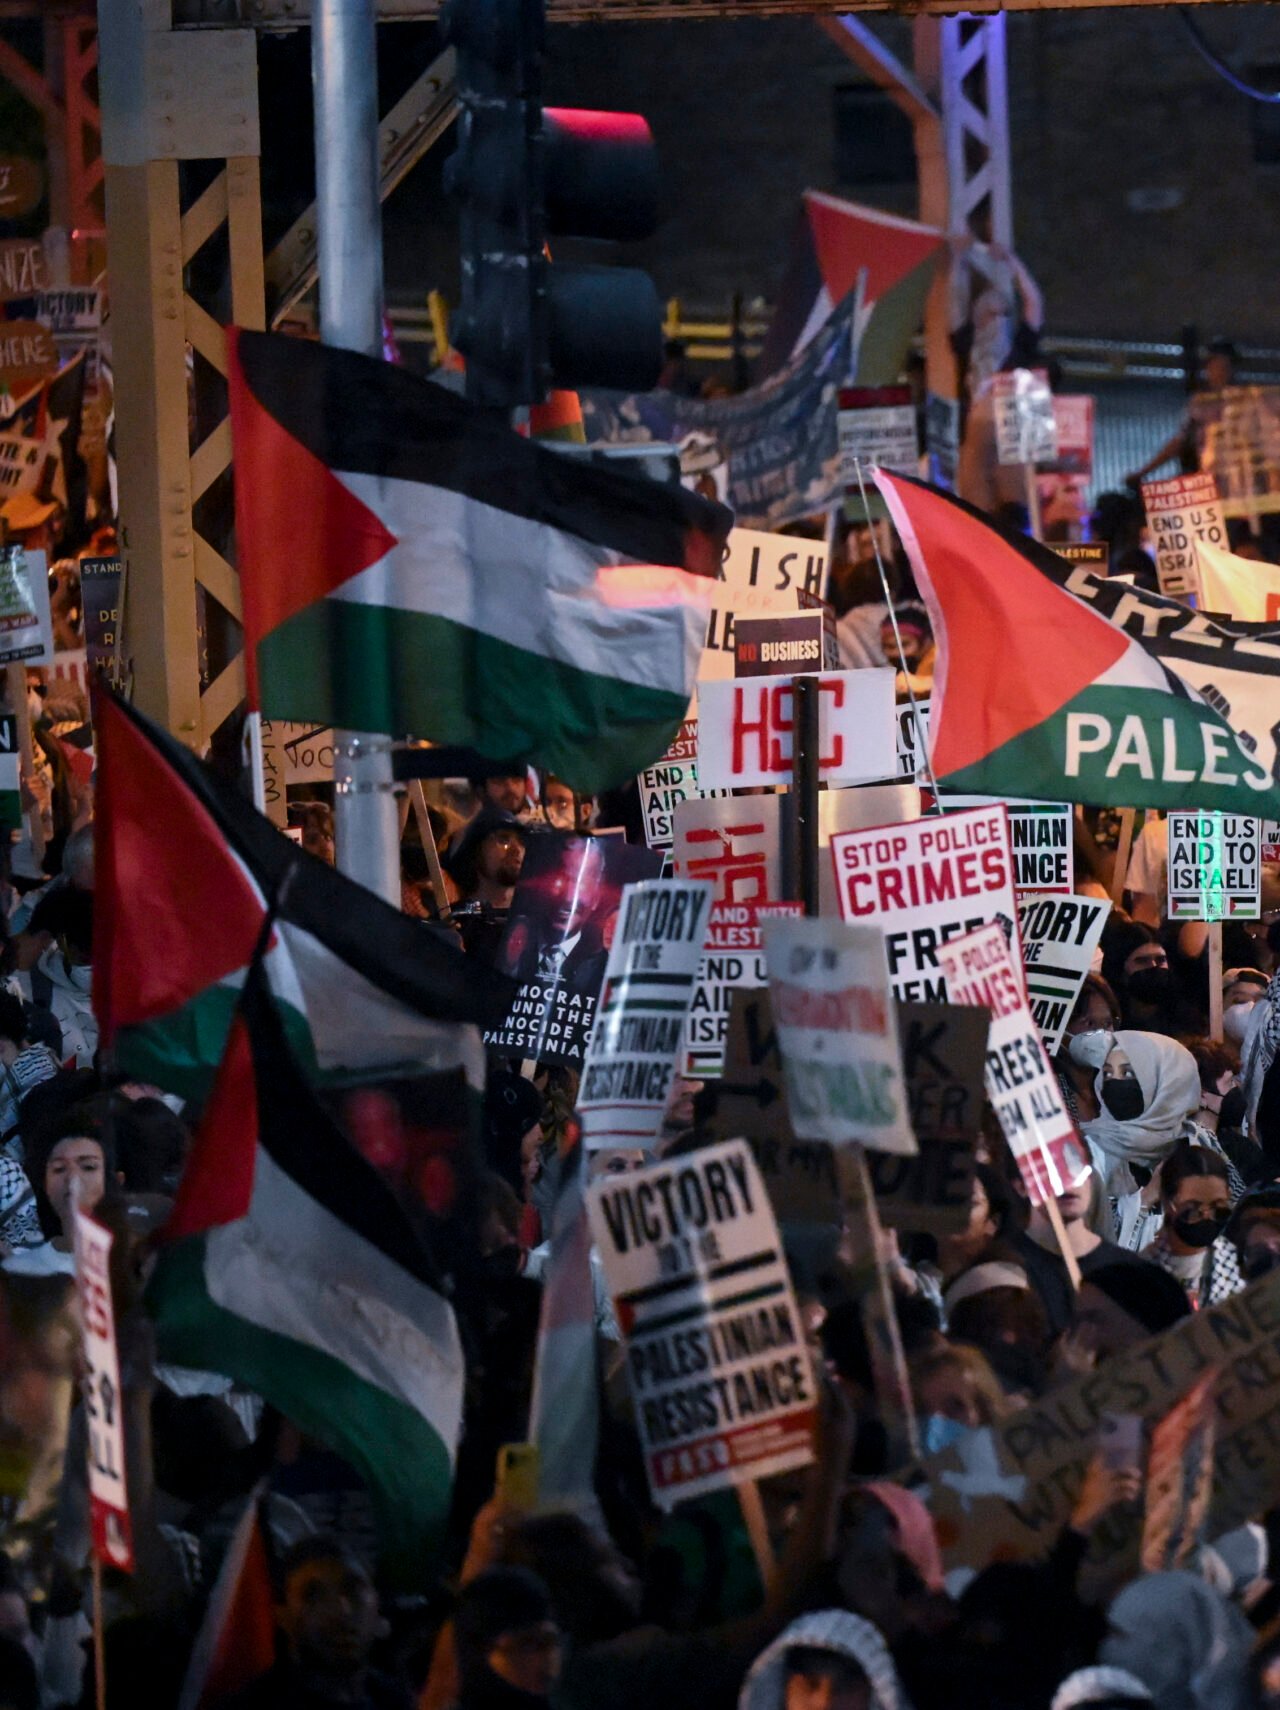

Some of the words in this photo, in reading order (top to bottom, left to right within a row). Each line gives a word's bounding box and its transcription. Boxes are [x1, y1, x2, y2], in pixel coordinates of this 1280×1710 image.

[1143, 480, 1181, 497] STAND
[1183, 473, 1214, 491] WITH
[1146, 488, 1217, 512] PALESTINE!
[1152, 514, 1184, 534] END
[1190, 508, 1217, 526] U.S
[1156, 530, 1188, 551] AID
[1055, 548, 1102, 560] ALESTINE
[761, 640, 819, 661] BUSINESS
[643, 766, 684, 789] END
[1173, 819, 1214, 838] END
[1223, 818, 1255, 838] U.S
[843, 836, 907, 870] STOP
[919, 817, 1002, 857] POLICE
[1173, 843, 1215, 864] AID
[1225, 843, 1256, 863] TO
[846, 848, 1007, 917] CRIMES
[1173, 868, 1256, 889] ISRAEL!
[709, 906, 749, 924] AND
[512, 1000, 546, 1017] UND
[556, 1006, 592, 1027] THE
[504, 1014, 574, 1040] NOCIDE
[601, 1153, 756, 1254] VICTORY
[630, 1304, 797, 1390] PALESTINIAN
